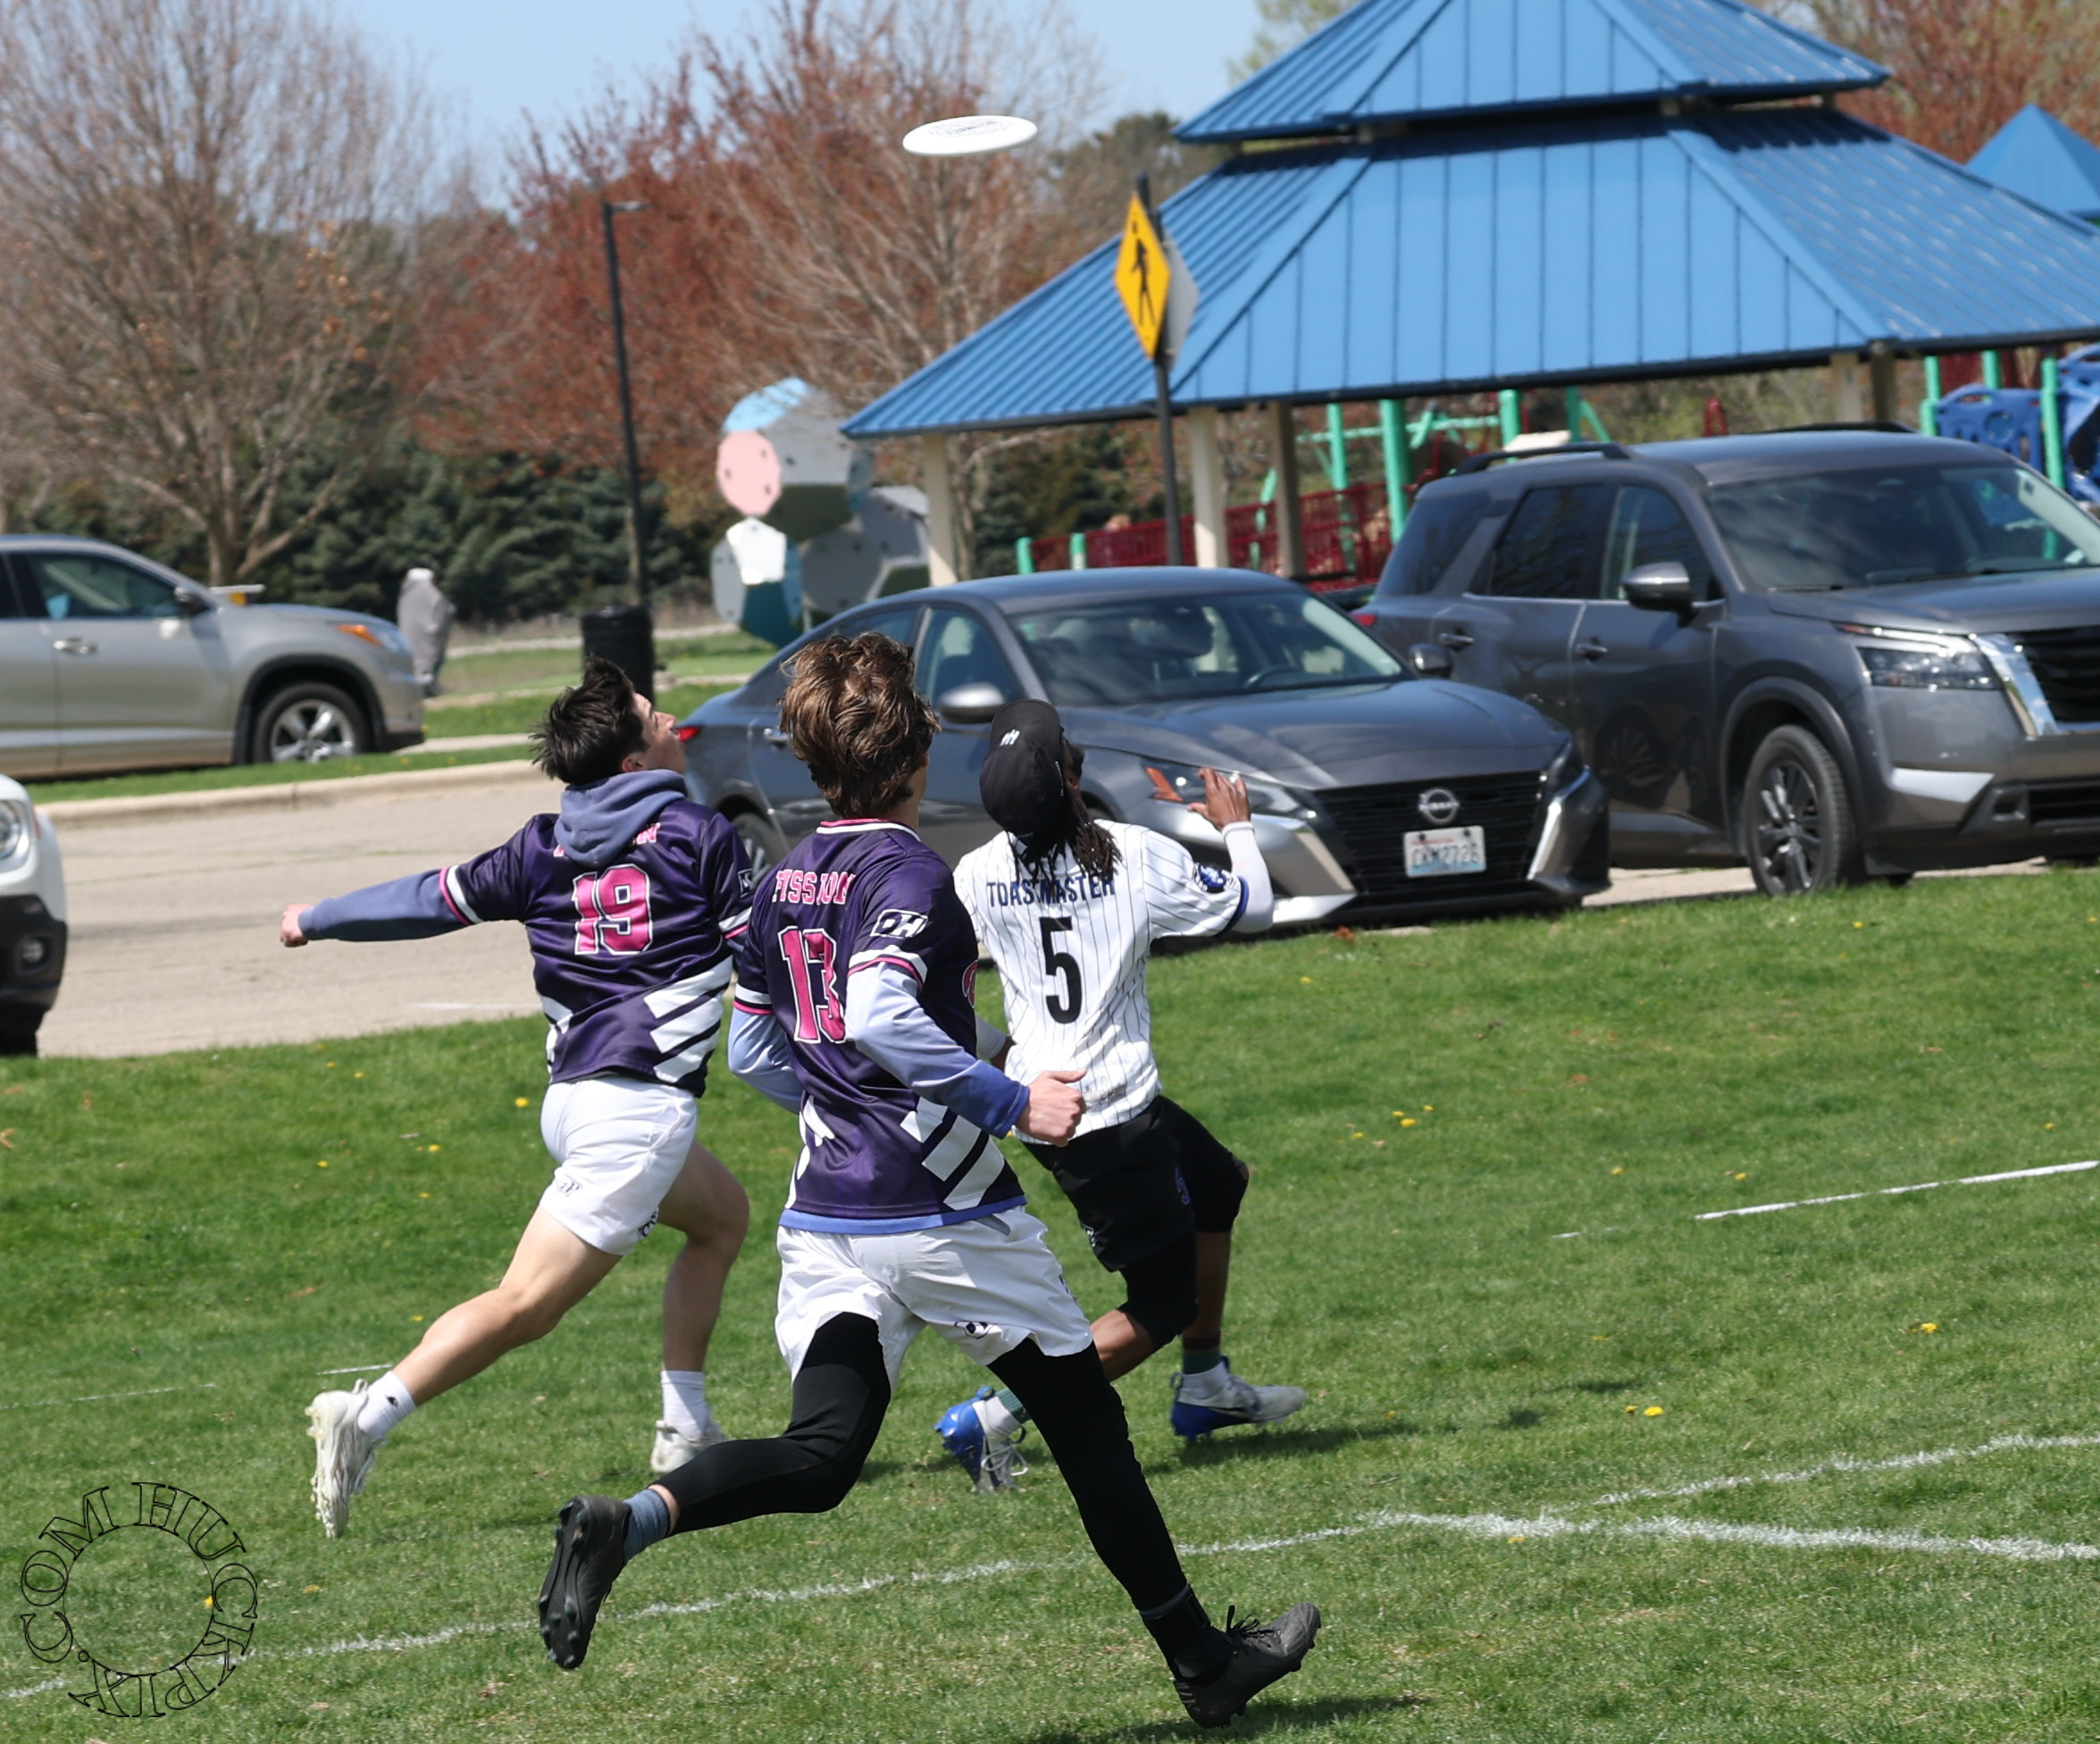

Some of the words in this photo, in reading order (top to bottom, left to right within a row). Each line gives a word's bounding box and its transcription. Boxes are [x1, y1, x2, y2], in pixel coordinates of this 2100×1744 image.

[571, 863, 653, 955] 19
[777, 925, 848, 1044] 13
[1039, 915, 1083, 1024] 5
